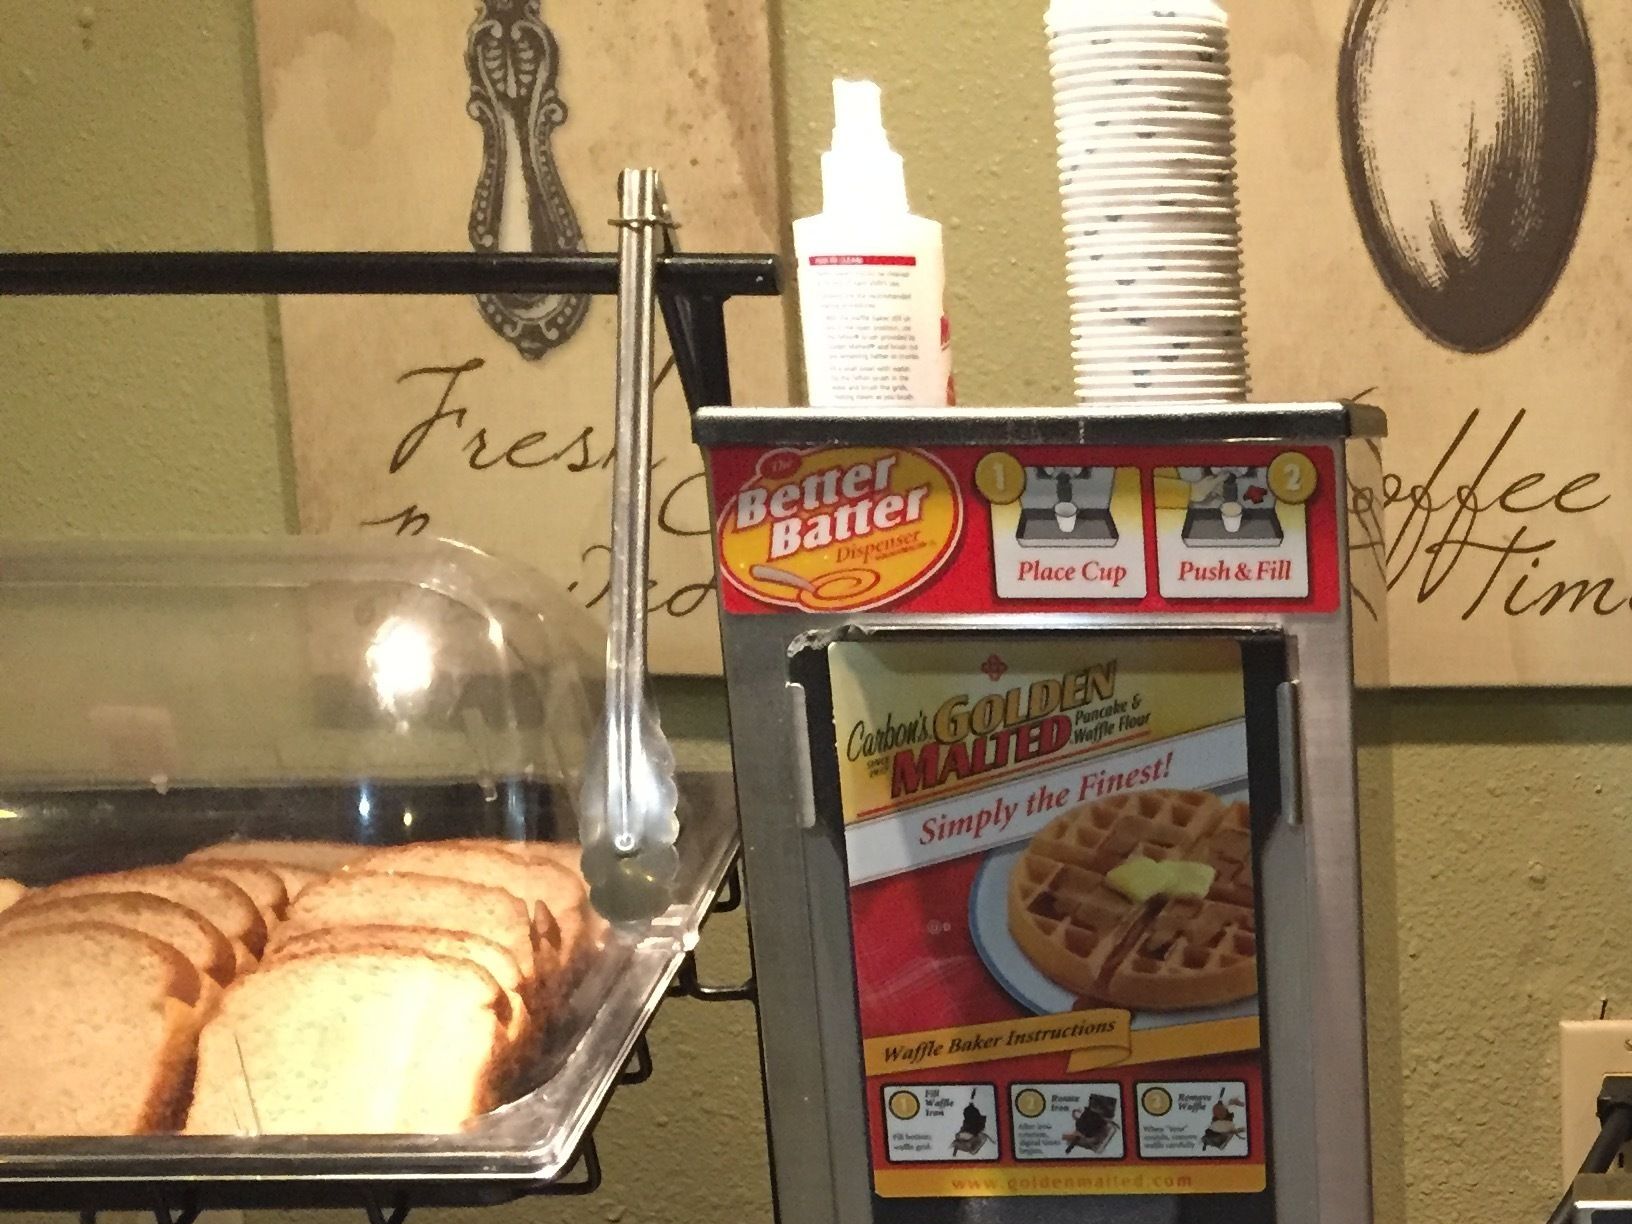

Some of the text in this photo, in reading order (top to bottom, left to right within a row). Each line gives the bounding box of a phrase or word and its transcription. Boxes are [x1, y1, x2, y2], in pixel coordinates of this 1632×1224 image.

[736, 455, 897, 530] Better
[1345, 387, 1612, 604] offee
[769, 486, 929, 560] Batter
[836, 530, 921, 564] Dispenser
[1017, 560, 1127, 586] Place Cup
[1178, 560, 1292, 581] Push & Fill
[847, 658, 1118, 762] Carbon's GOLDEN
[1073, 712, 1152, 745] Waffle Flour
[1074, 699, 1129, 726] Pancake
[890, 714, 1073, 798] MALTED
[918, 751, 1175, 846] Simply the Finest!
[882, 1017, 1117, 1063] Waffle Baker Instructions
